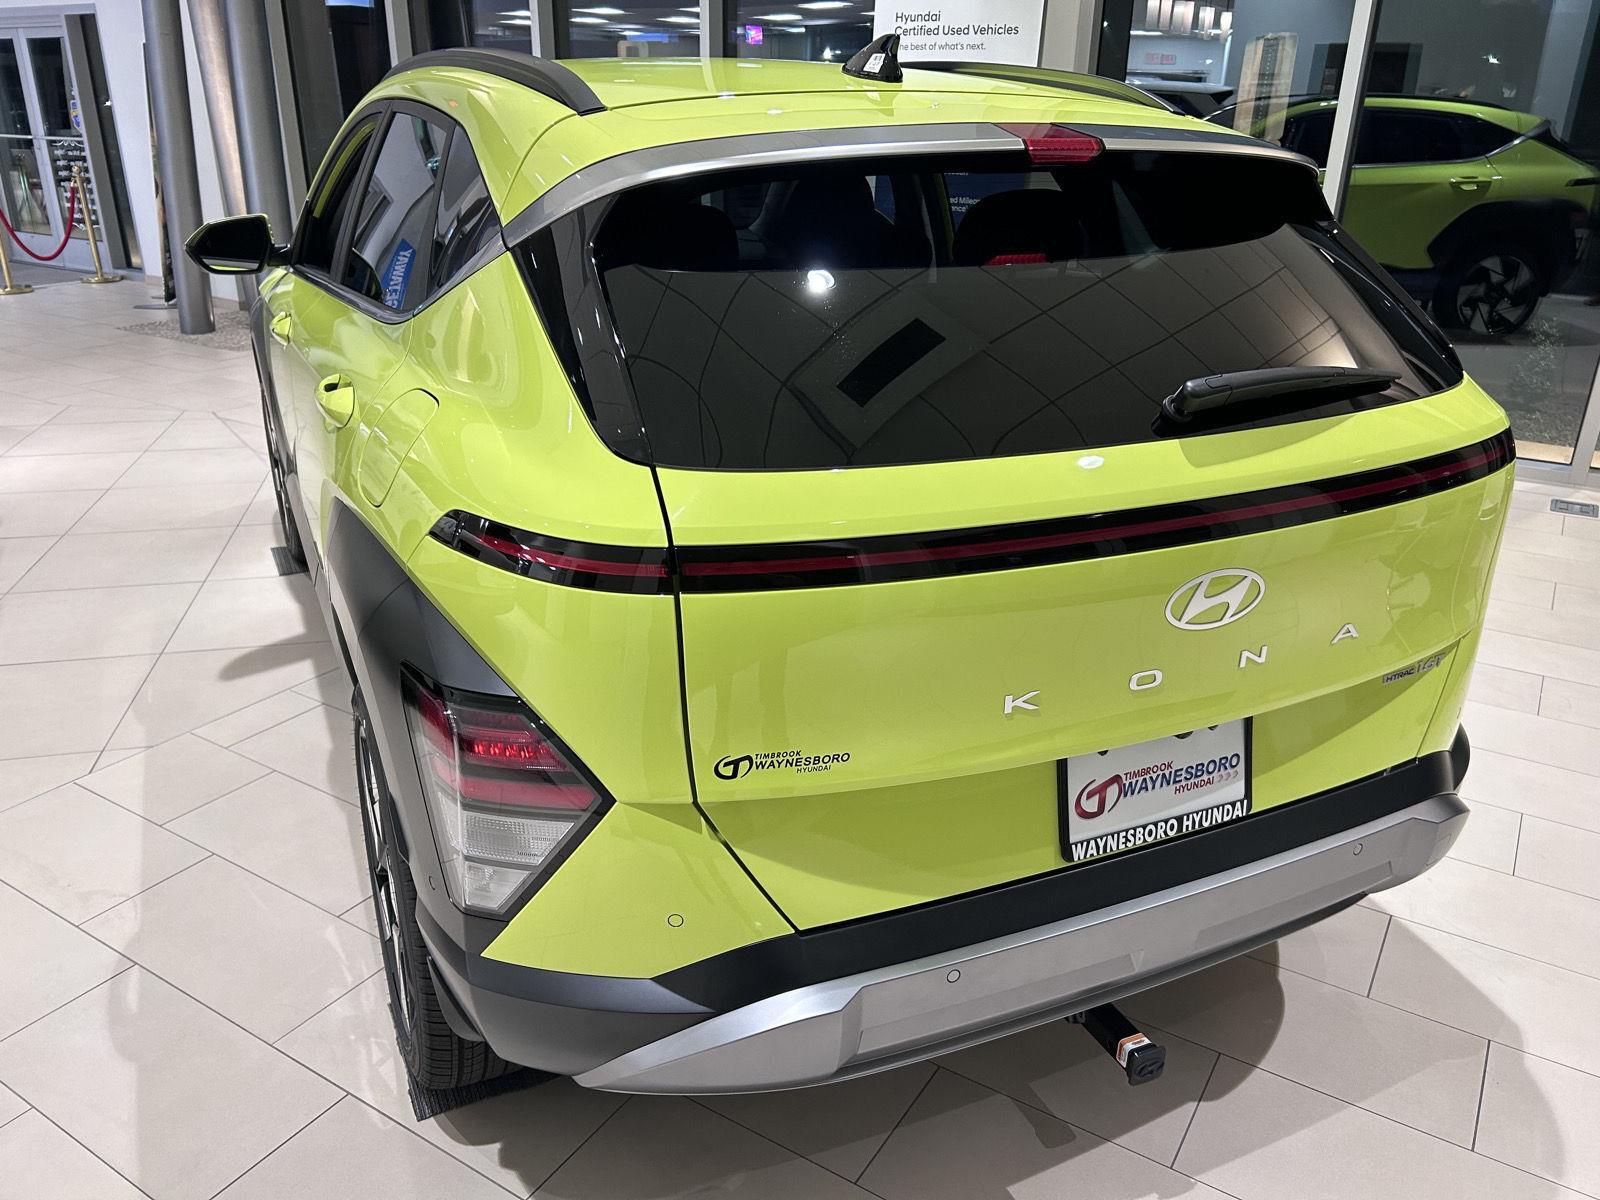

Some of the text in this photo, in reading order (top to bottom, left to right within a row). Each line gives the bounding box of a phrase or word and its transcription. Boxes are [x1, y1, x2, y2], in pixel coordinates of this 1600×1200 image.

[895, 11, 941, 25] Hyundai
[895, 23, 1019, 37] Certified Used Vehicles
[910, 42, 927, 51] best
[928, 42, 937, 51] of
[938, 42, 965, 51] what's
[966, 43, 986, 51] next.
[1003, 622, 1359, 715] KONA
[1385, 667, 1415, 683] HTRAC
[754, 752, 851, 770] WAYNESBORO
[755, 750, 802, 760] TIMBROOK
[796, 765, 832, 774] HYUNDAI
[1122, 753, 1241, 798] WAYNESBORO
[1124, 761, 1174, 781] TIMBROOK
[1174, 776, 1215, 795] HYUNDAI
[1071, 800, 1248, 862] WAYNESBORO HYUNDAI
